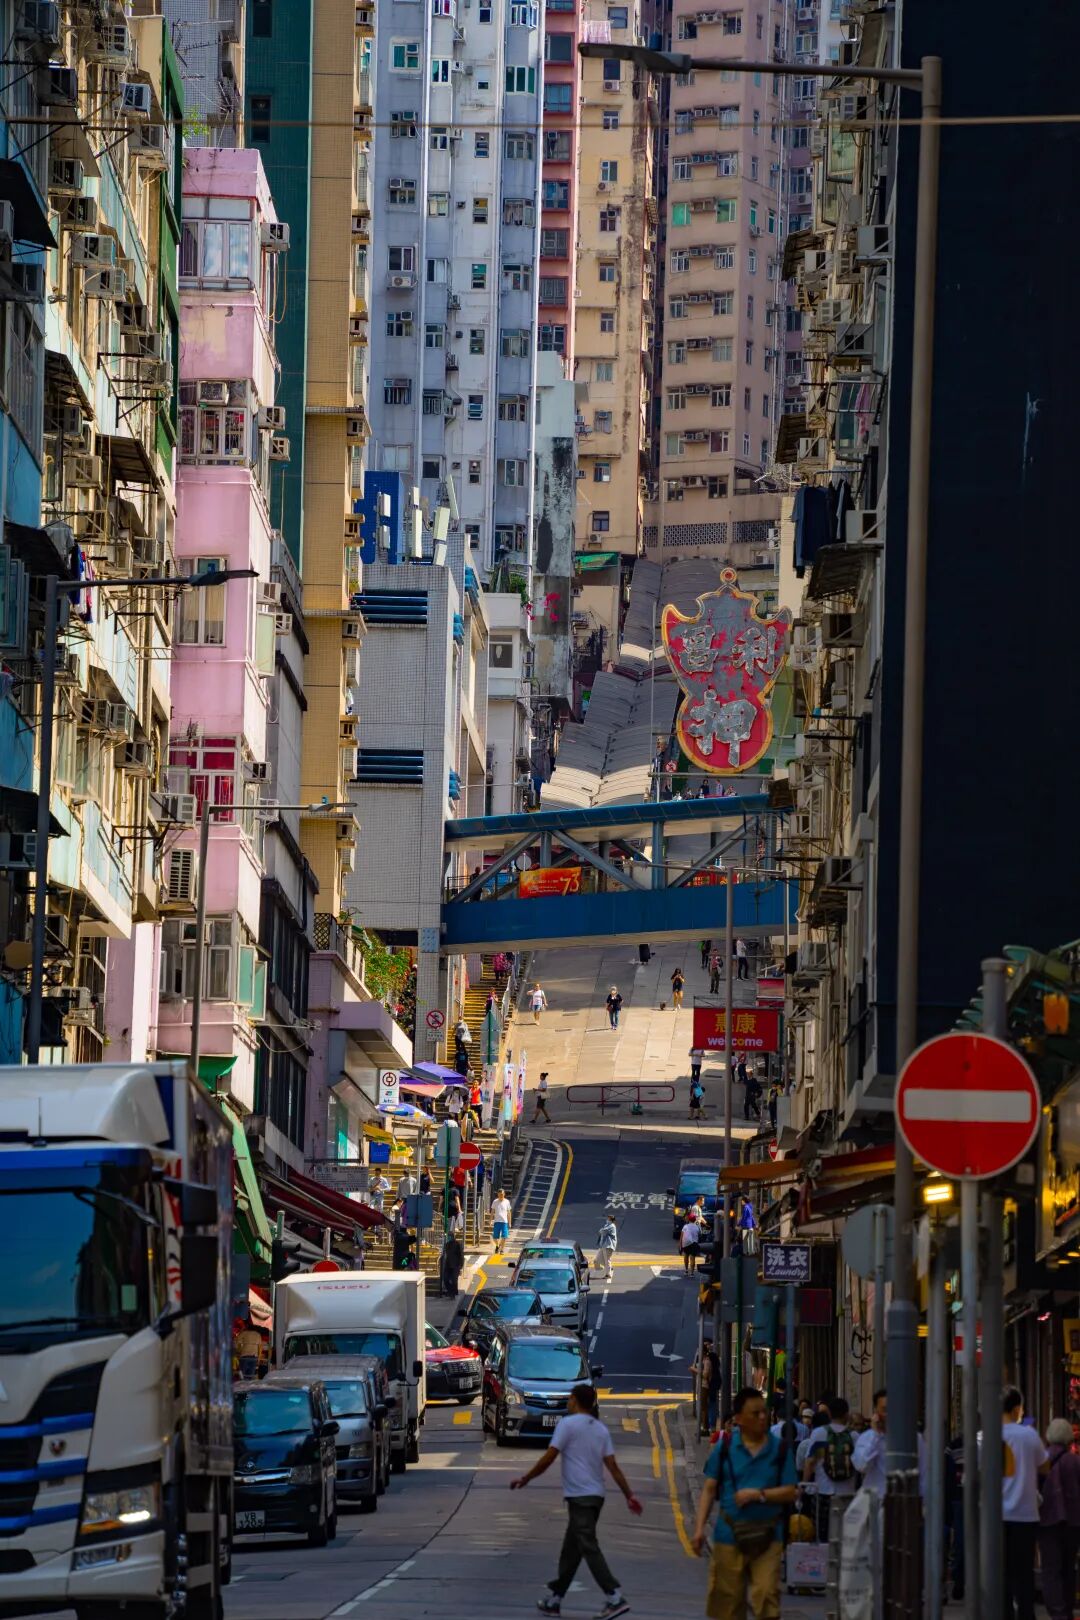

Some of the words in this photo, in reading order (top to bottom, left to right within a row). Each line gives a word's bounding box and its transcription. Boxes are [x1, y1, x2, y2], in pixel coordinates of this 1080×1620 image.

[707, 1036, 764, 1047] wecome
[767, 1247, 808, 1267] 洗衣
[766, 1266, 808, 1279] Laundry
